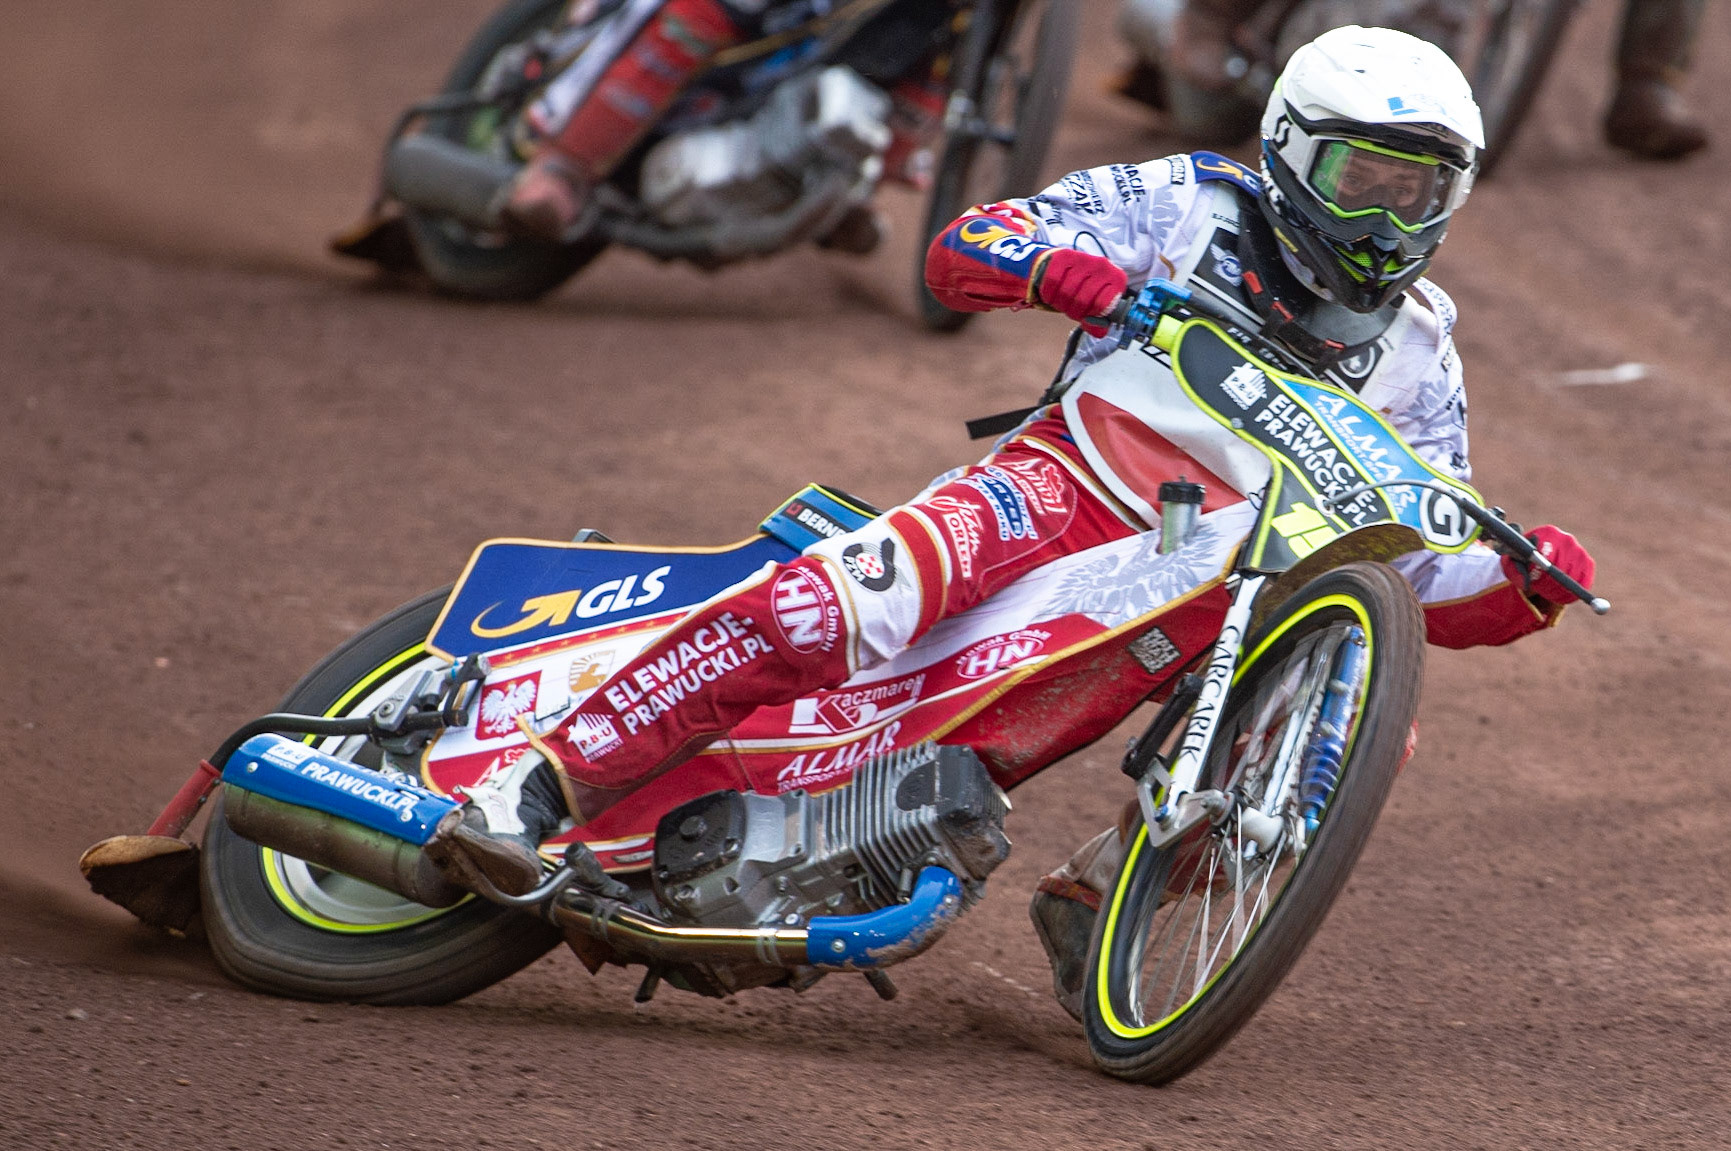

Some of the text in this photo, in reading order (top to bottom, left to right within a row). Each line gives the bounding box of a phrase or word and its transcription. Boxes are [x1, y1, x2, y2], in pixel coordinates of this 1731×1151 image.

[575, 565, 671, 618] GLS
[776, 576, 823, 647] HN
[797, 566, 840, 653] Nowak GmbH
[604, 611, 754, 713] ELEWACJE-
[621, 633, 775, 736] PRAWUCKI.PL
[966, 640, 1035, 676] HN
[776, 720, 902, 782] ALMAR
[300, 761, 419, 813] PRAWUCKI.PL
